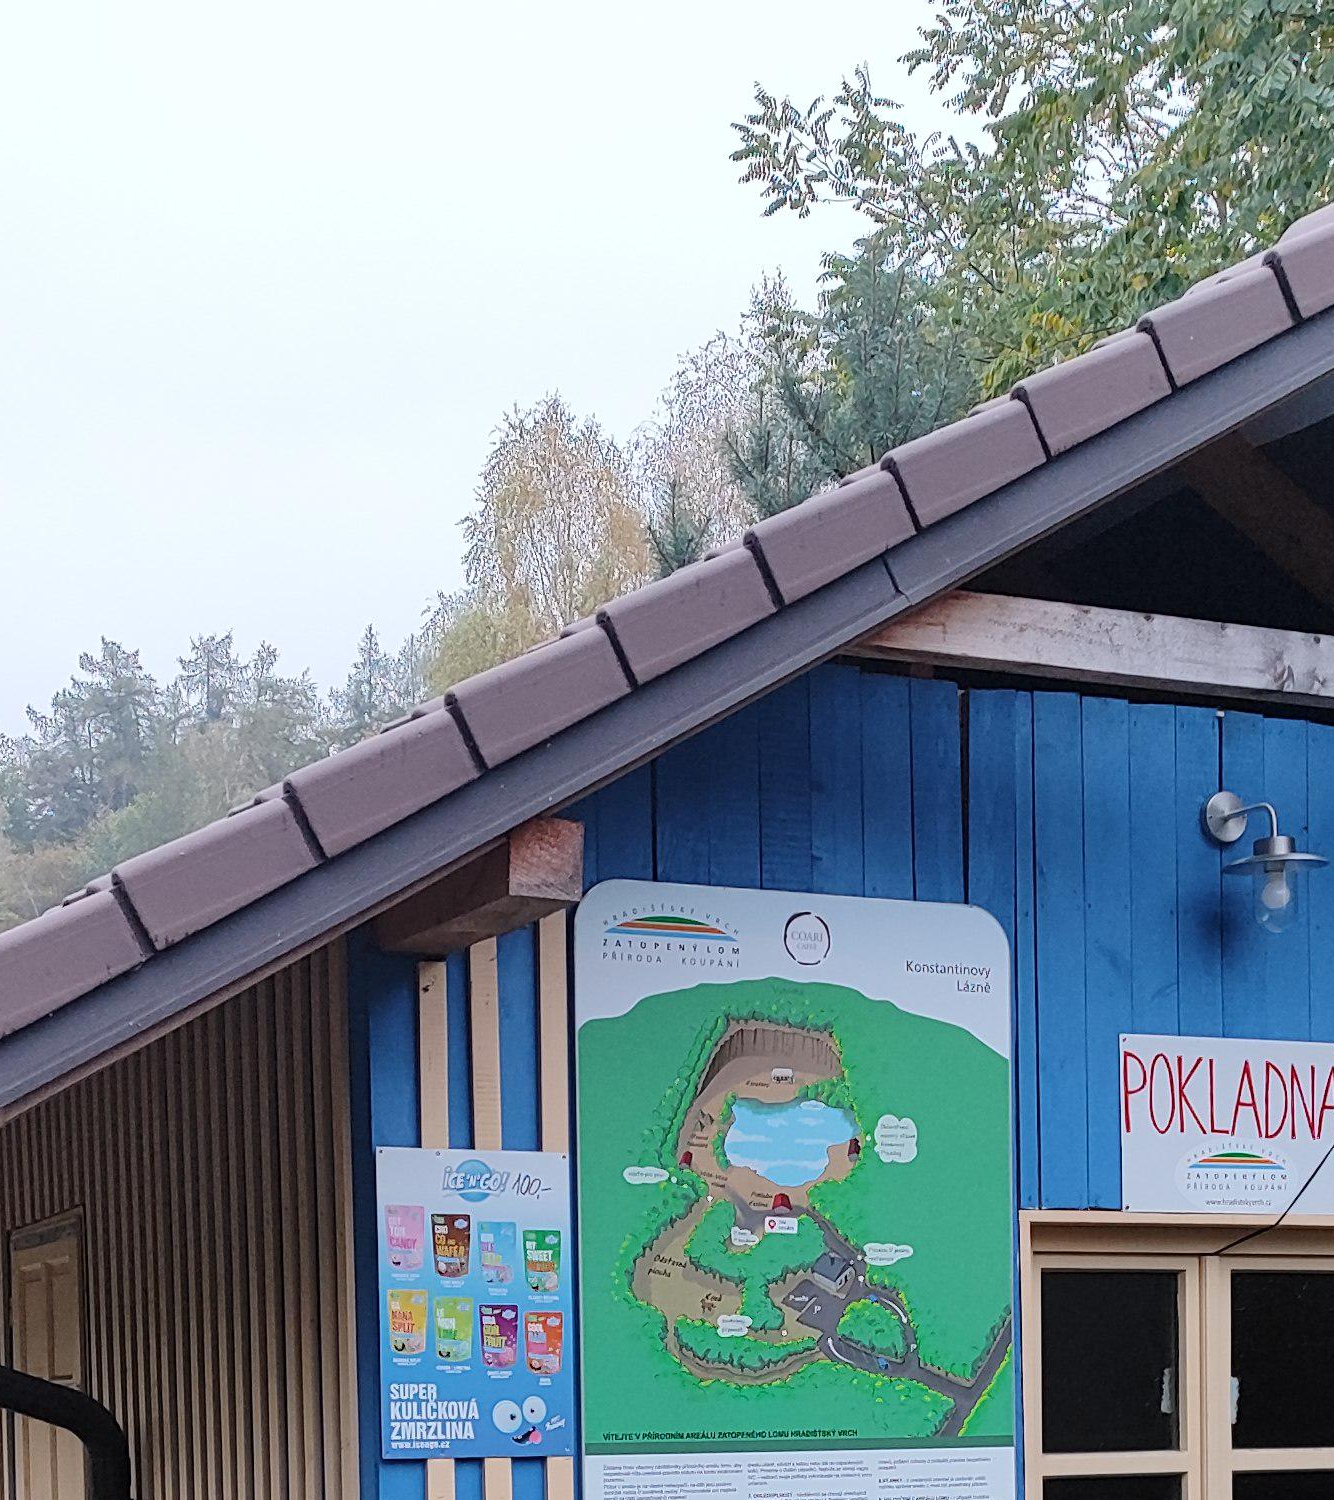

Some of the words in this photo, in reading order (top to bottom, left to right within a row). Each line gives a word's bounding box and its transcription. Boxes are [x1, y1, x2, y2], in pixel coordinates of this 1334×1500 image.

[706, 945, 740, 956] LOM
[602, 951, 663, 965] PŘÍRODA
[680, 956, 740, 969] KOUPÁNÍ
[906, 960, 992, 979] Konstantinovy
[957, 979, 992, 994] Lázně
[389, 1382, 438, 1400] SUPER
[390, 1397, 480, 1420] KULIČKOVÁ
[390, 1421, 475, 1440] ZMRZLINA
